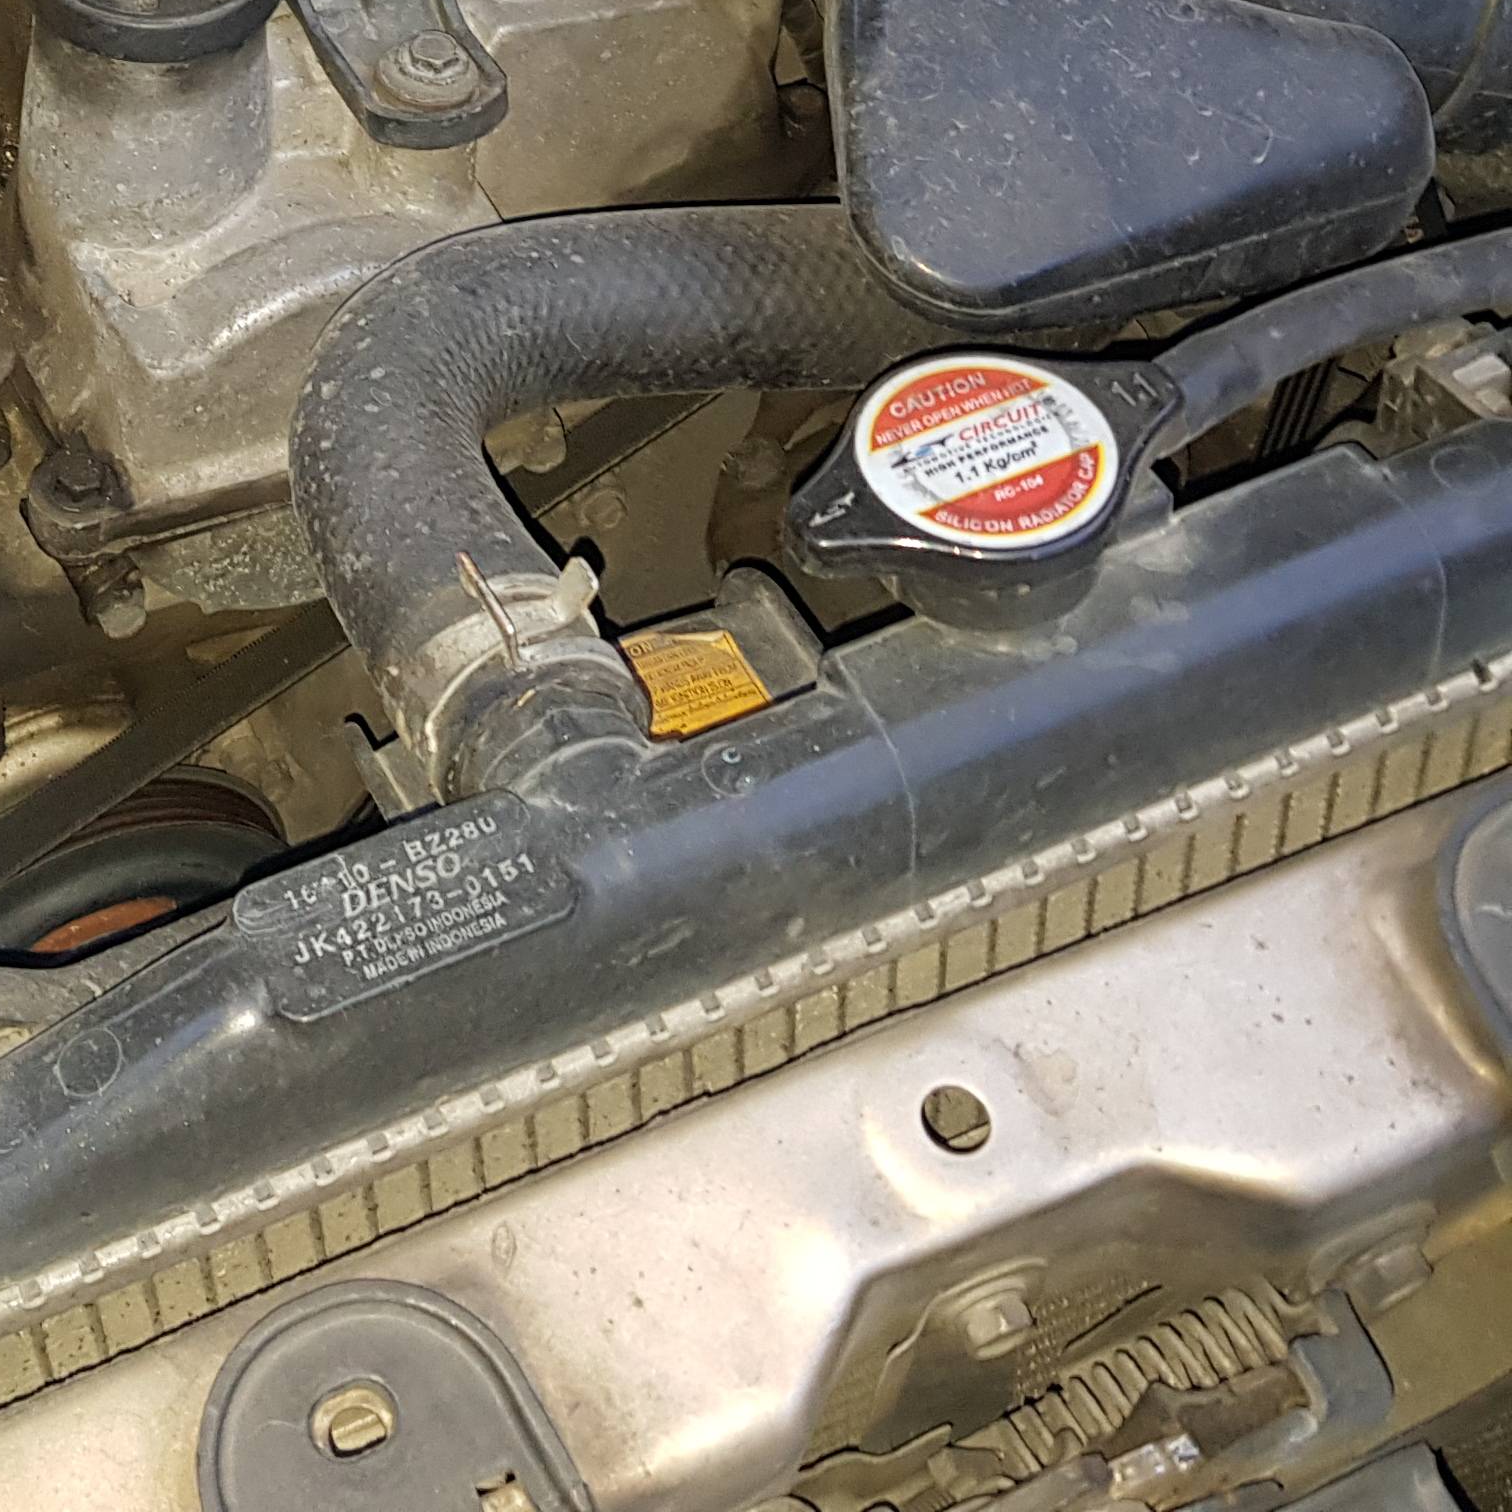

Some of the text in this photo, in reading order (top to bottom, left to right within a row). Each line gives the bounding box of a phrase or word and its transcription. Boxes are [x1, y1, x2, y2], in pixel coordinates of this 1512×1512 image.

[875, 378, 1030, 446] NEVER OPEN WHEN HOT
[889, 371, 986, 418] CAUTION
[959, 402, 1042, 442] CIRCUIT
[925, 425, 1049, 478] HIGH PERFORMANCE
[955, 465, 980, 484] 1.1
[936, 452, 1096, 533] SILICON RADIATOR CAP
[341, 851, 461, 919] DENSO
[427, 890, 509, 932] INDONESIA
[362, 953, 409, 980] MADE
[424, 912, 507, 955] INDONESIA
